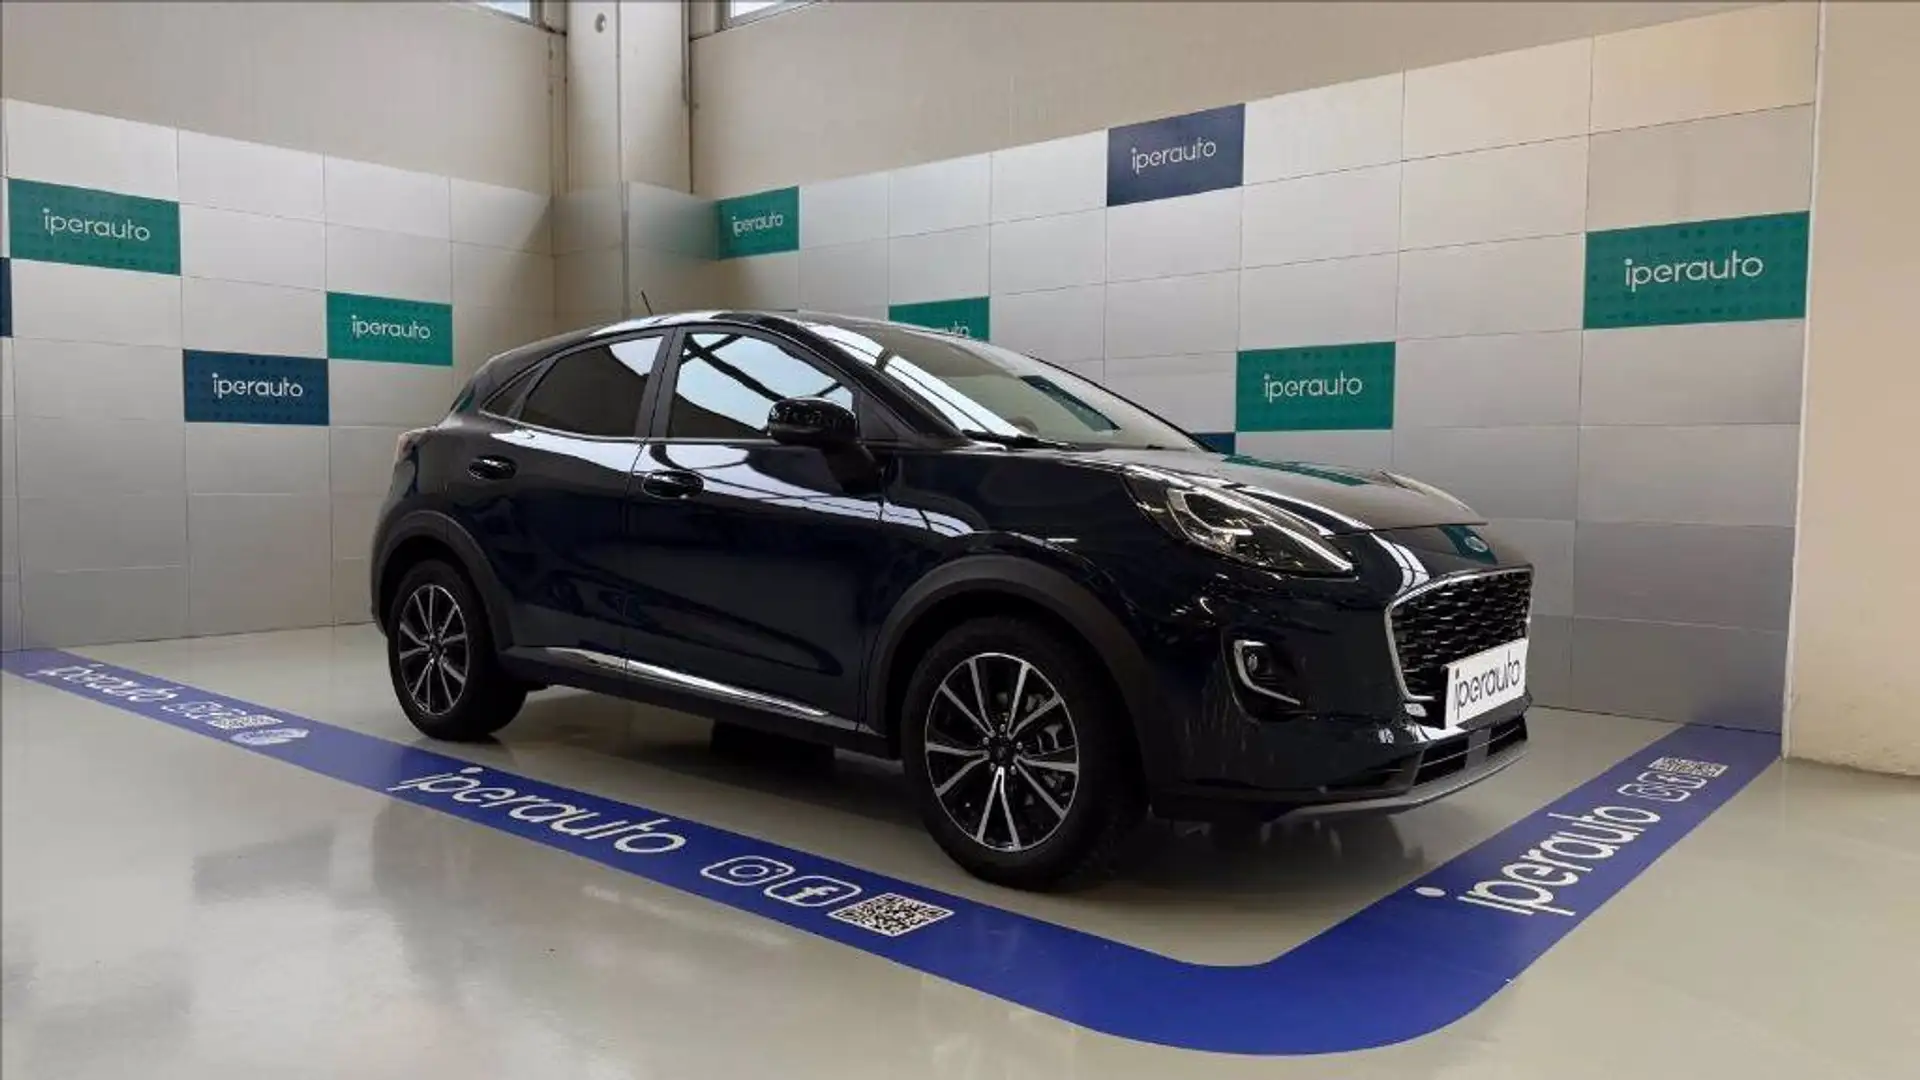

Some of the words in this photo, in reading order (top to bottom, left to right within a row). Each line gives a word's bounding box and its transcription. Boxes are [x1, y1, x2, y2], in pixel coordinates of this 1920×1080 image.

[1131, 137, 1217, 174] iperauto
[43, 208, 151, 241] iperauto
[732, 213, 783, 236] iperauto
[1624, 250, 1764, 293] iperauto
[352, 314, 431, 338] iperauto
[211, 372, 303, 399] iperauto
[1263, 371, 1363, 403] iperauto
[1453, 651, 1521, 719] iperauto
[387, 767, 686, 853] iperauto
[1415, 805, 1661, 917] iperauto
